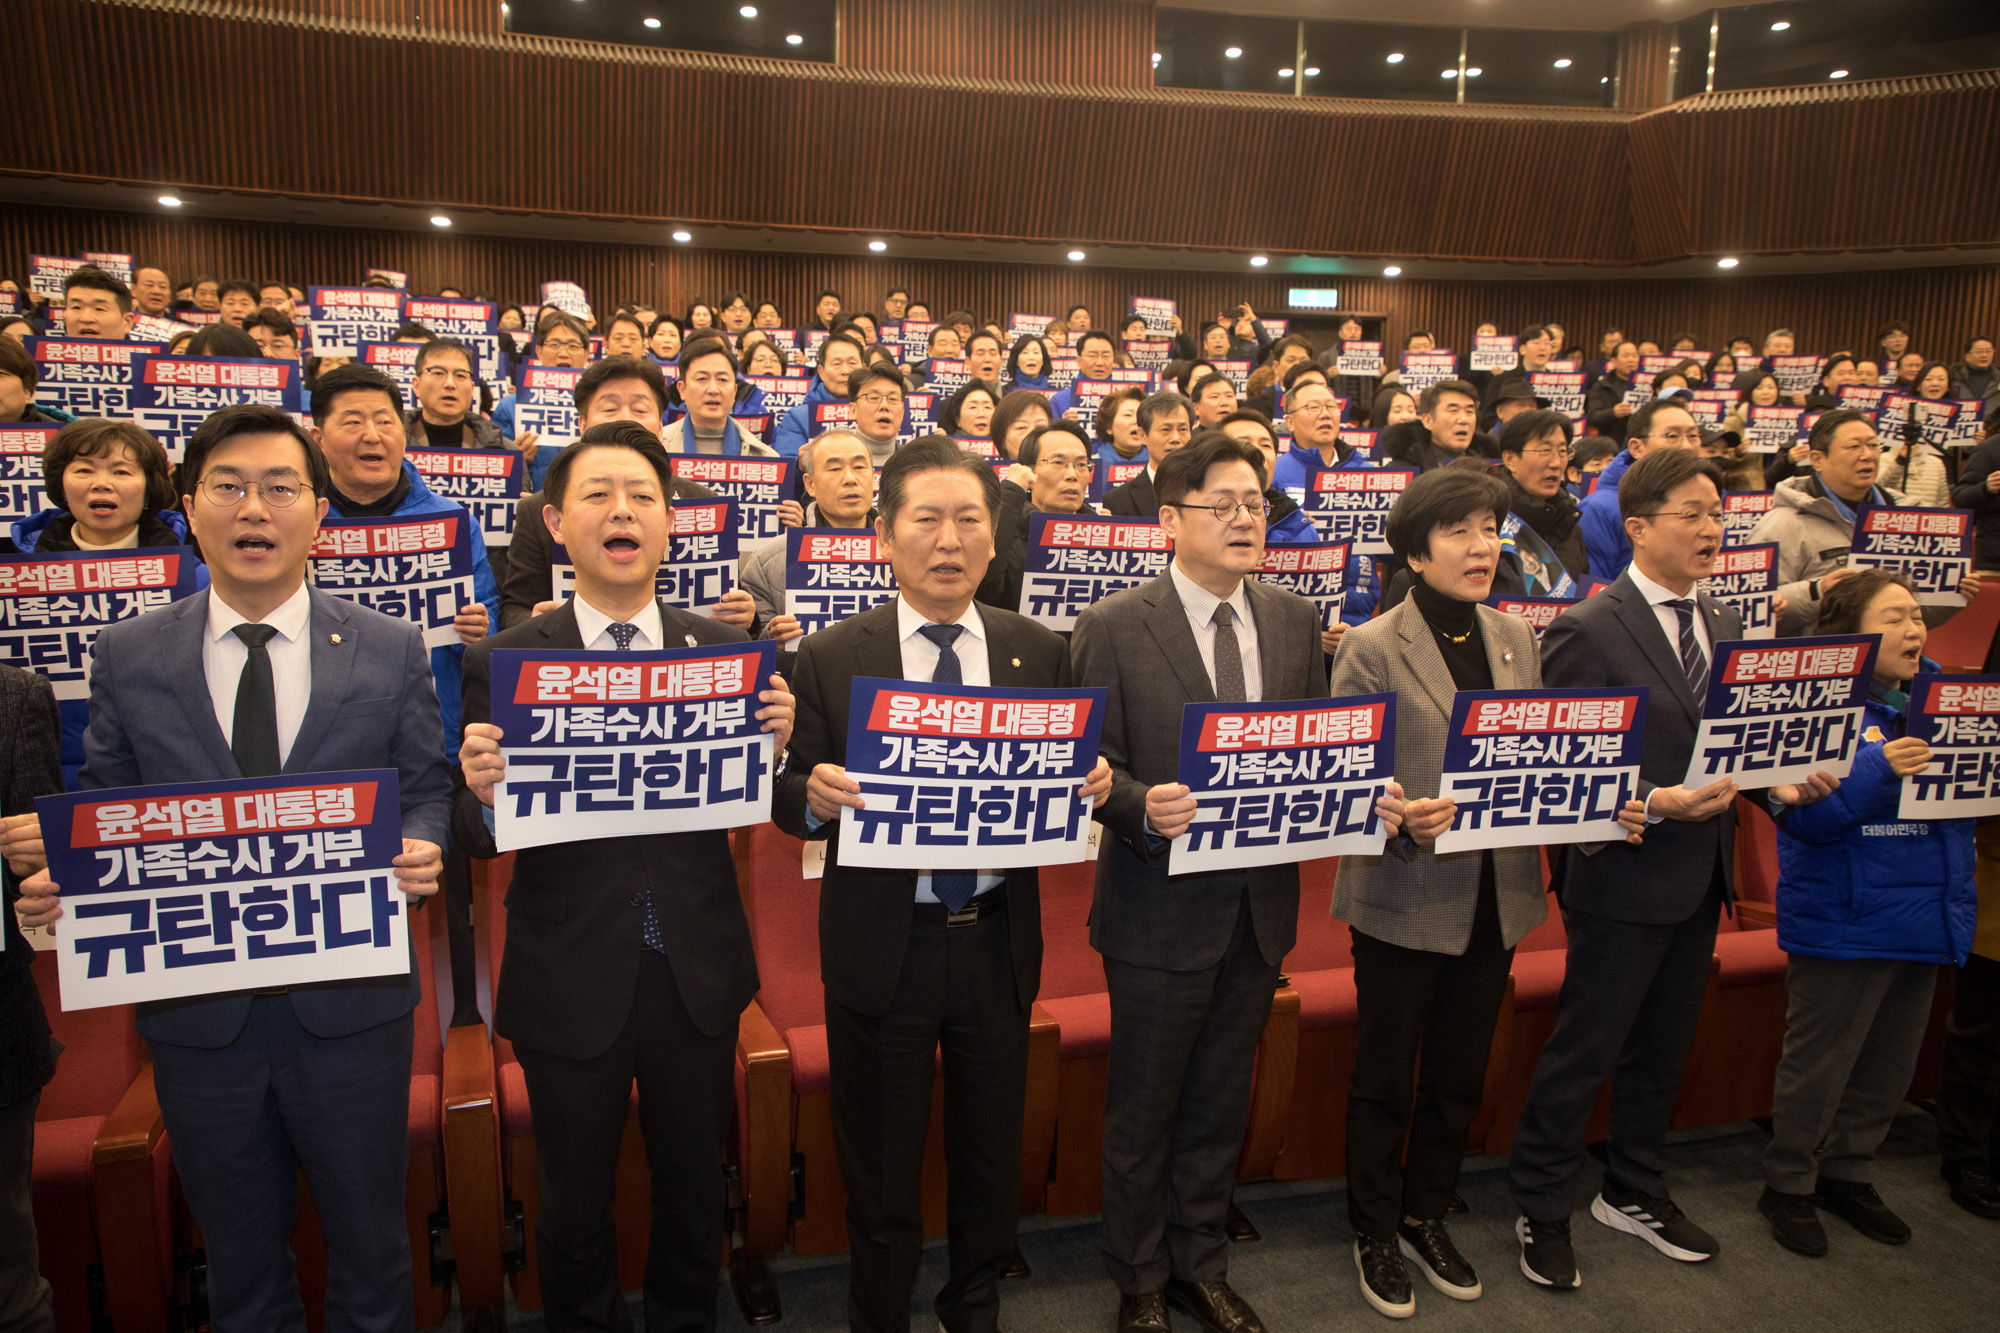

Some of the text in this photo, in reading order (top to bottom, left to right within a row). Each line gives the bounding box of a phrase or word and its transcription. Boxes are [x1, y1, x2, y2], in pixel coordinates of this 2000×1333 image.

[323, 291, 396, 308] 윤석열 대통령
[412, 302, 485, 320] 윤석열 대통령
[322, 306, 376, 320] 가족수사
[1144, 318, 1174, 332] 탄한다
[317, 324, 394, 347] 규탄한
[410, 318, 488, 335] 족수사 거부
[46, 343, 99, 362] 윤석열
[1340, 358, 1382, 370] 규탄한다
[44, 363, 120, 382] 가족수사
[156, 362, 216, 384] 윤석열
[220, 365, 280, 386] 대통령
[532, 372, 574, 388] 윤석열
[35, 386, 134, 418] 규탄한
[154, 386, 240, 408] 가족수사
[530, 390, 575, 404] 가족수
[1551, 396, 1582, 412] 한다
[521, 408, 579, 436] 규탄
[822, 405, 855, 421] 윤석
[0, 432, 46, 452] 통령
[453, 455, 504, 474] 대통령
[678, 460, 778, 482] 윤석열 대통령
[1114, 466, 1146, 482] 윤석
[471, 477, 506, 497] 거부
[746, 484, 779, 503] 거부
[1322, 473, 1406, 490] 윤석열 대통령
[1318, 492, 1378, 510] 가족수사
[1730, 497, 1764, 512] 윤석열
[670, 508, 716, 534] 통령
[1314, 514, 1386, 543] 규탄한
[1872, 512, 1960, 534] 윤석열 대통령
[311, 522, 446, 555] 석열 대통령
[676, 534, 720, 560] 거부
[1052, 522, 1167, 550] 윤석열 대통령
[1865, 534, 1962, 556] 가족수사 거부
[810, 538, 871, 560] 윤석열
[1302, 548, 1344, 570] 대통령
[403, 551, 452, 580] 거부
[1046, 549, 1168, 574] 가족수사 거부
[1728, 551, 1766, 572] 대통령
[82, 558, 166, 590] 대통령
[807, 564, 893, 588] 가족수사
[1314, 571, 1342, 594] 거부
[1741, 572, 1768, 592] 거부
[1736, 646, 1860, 680] 윤석열 대통령
[537, 658, 743, 700] 윤석열 대통령
[1726, 678, 1854, 714] 가족수사 거부
[531, 698, 746, 743] 가족수사 거부
[888, 695, 1076, 736] 윤석열 대통령
[1477, 700, 1624, 732] 윤석열 대통령
[1216, 708, 1372, 748] 윤석열 대통령
[1932, 717, 2000, 744] 가족수
[1468, 734, 1624, 768] 가족수사 거부
[1703, 712, 1856, 774] 규탄한다
[879, 736, 1074, 775] 가족수사 거부
[1208, 744, 1374, 786] 가족수사 거부
[506, 742, 767, 818] 규탄한다
[854, 781, 1088, 846] 규탄한다
[1450, 772, 1632, 832] 규탄한다
[95, 787, 356, 842] 윤석열 대통령
[1187, 785, 1385, 852] 규탄한다
[94, 830, 364, 887] 가족수사 거부
[74, 876, 399, 979] 규탄한다
